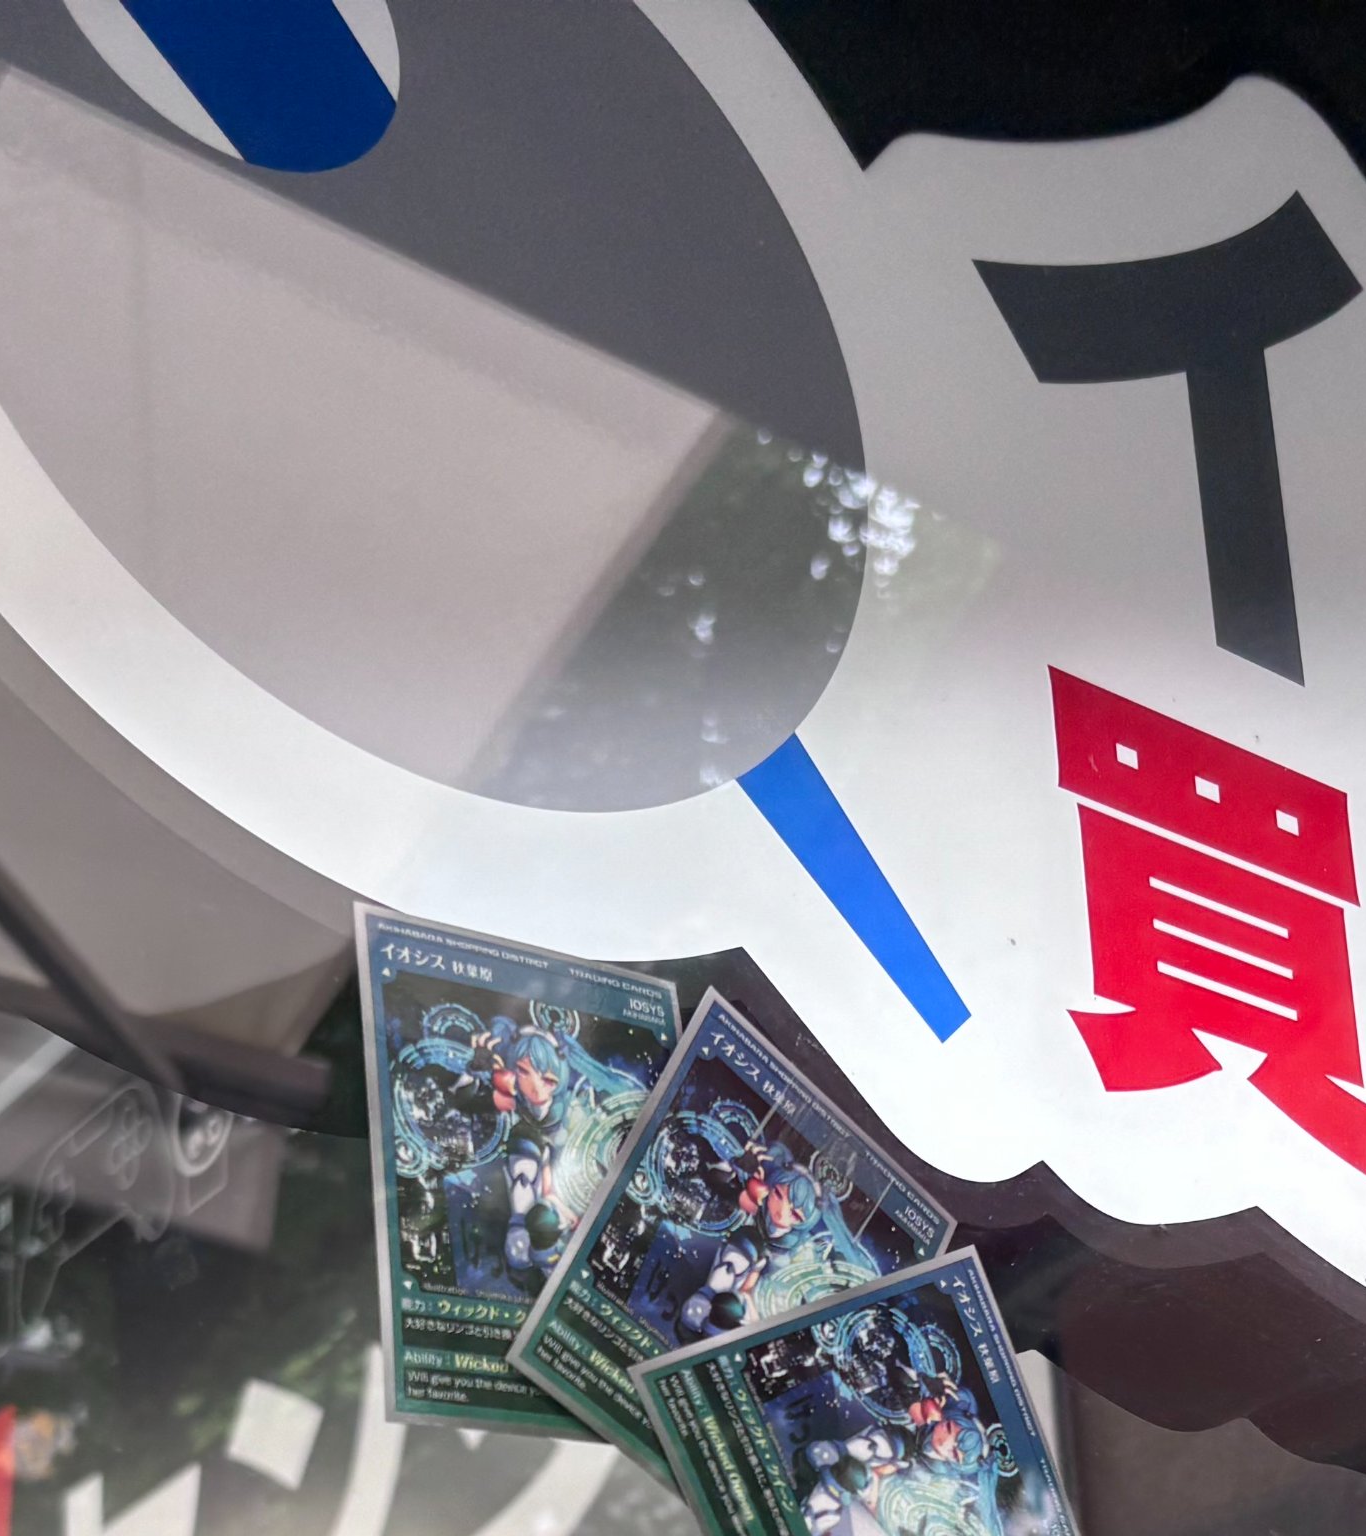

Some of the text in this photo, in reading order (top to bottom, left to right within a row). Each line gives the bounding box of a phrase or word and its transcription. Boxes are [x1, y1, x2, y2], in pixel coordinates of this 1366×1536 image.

[379, 938, 493, 983] イオシス 秋葉原
[501, 950, 549, 970] DISTRICT
[629, 997, 666, 1018] IOSYS
[706, 1024, 797, 1117] イオシス 秋葉原
[717, 1011, 770, 1064] AKIHABARA
[905, 1189, 941, 1226] CARDS
[903, 1204, 936, 1240] IOSYS
[949, 1272, 1000, 1385] イオシス 秋葉原
[407, 1386, 426, 1398] her
[453, 1377, 474, 1391] you
[474, 1377, 492, 1390] the
[578, 1365, 598, 1387] you
[701, 1414, 734, 1472] Wicked
